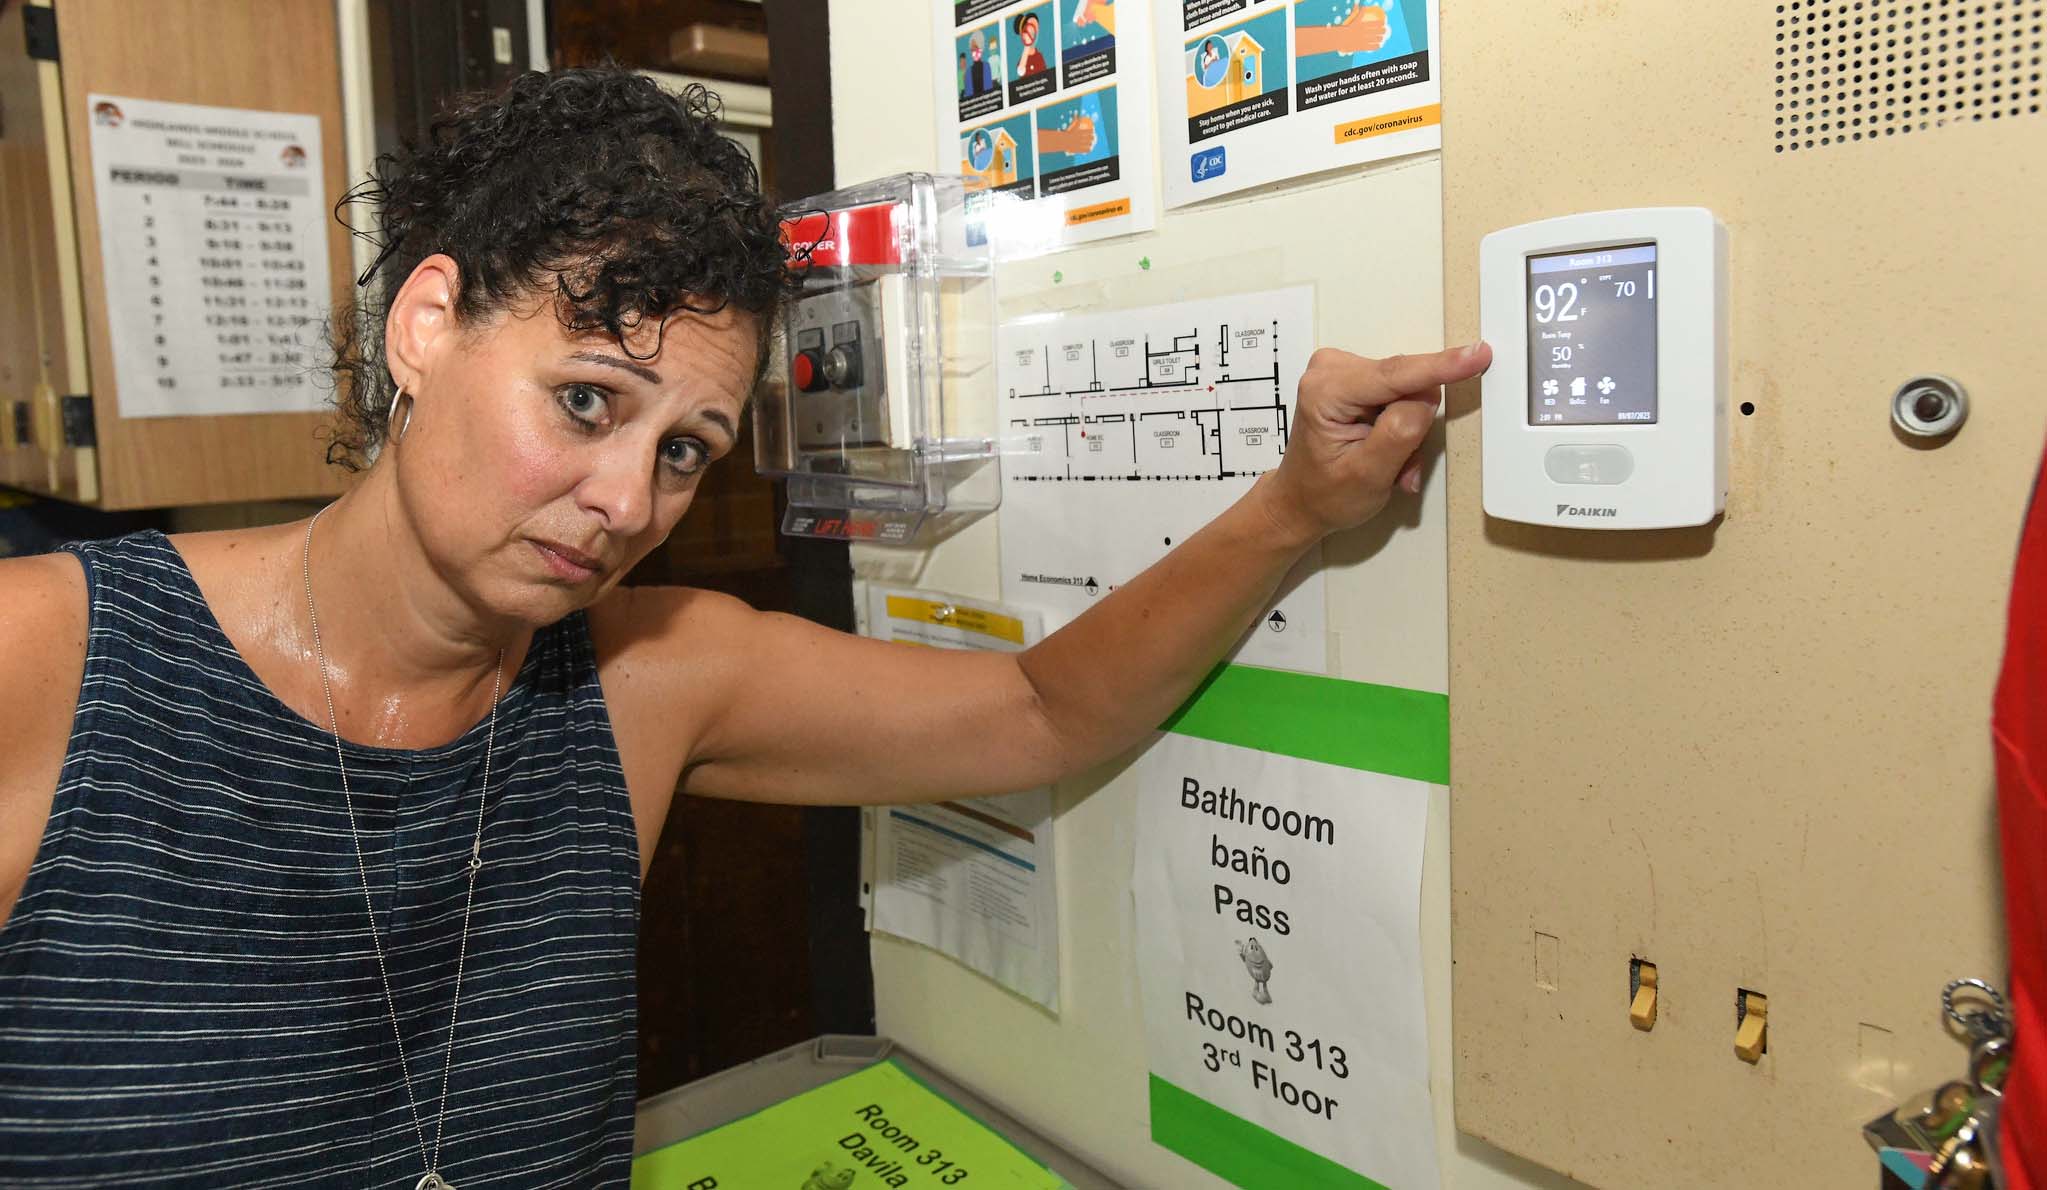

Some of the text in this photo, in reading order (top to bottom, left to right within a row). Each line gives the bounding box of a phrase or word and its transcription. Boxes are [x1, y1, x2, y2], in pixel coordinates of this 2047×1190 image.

[1186, 10, 1198, 20] cloth
[1198, 7, 1208, 15] face
[1188, 3, 1241, 29] your nose and mouth.
[1304, 61, 1418, 94] Wash your hands often with soap
[1304, 70, 1418, 104] and water for at least 20 seconds.
[1199, 98, 1274, 128] Stay home when you are sick,
[1202, 124, 1219, 134] except
[1226, 120, 1235, 128] get
[1236, 112, 1256, 124] medical
[1257, 109, 1272, 118] care.
[1344, 114, 1423, 138] cdc.gov/coronavirus
[1209, 156, 1222, 166] CDC
[110, 169, 265, 191] PERIOD TIME
[144, 194, 150, 204] 1
[204, 195, 238, 206] 7:44
[145, 216, 154, 228] 2
[147, 236, 156, 248] 3
[149, 256, 158, 266] 4
[1570, 258, 1594, 267] Room
[151, 275, 160, 286] 5
[1614, 280, 1636, 298] 70
[1535, 282, 1588, 324] 92 F
[154, 314, 162, 325] 7
[155, 334, 165, 346] 8
[1234, 329, 1265, 338] CLASSROOM
[1542, 330, 1572, 340] Room Temp
[1552, 346, 1572, 362] 50
[158, 377, 176, 388] 10
[1600, 397, 1610, 405] Fan
[1568, 506, 1617, 517] DAIKIN
[1021, 574, 1083, 585] Home Economics 313
[1181, 776, 1334, 845] Bathroom
[1212, 834, 1290, 884] baño
[1214, 884, 1290, 936] Pass
[1186, 992, 1349, 1079] Room 313
[1202, 1042, 1338, 1120] 3rd Floor
[855, 1104, 968, 1187] Room 313
[838, 1132, 908, 1190] Davila
